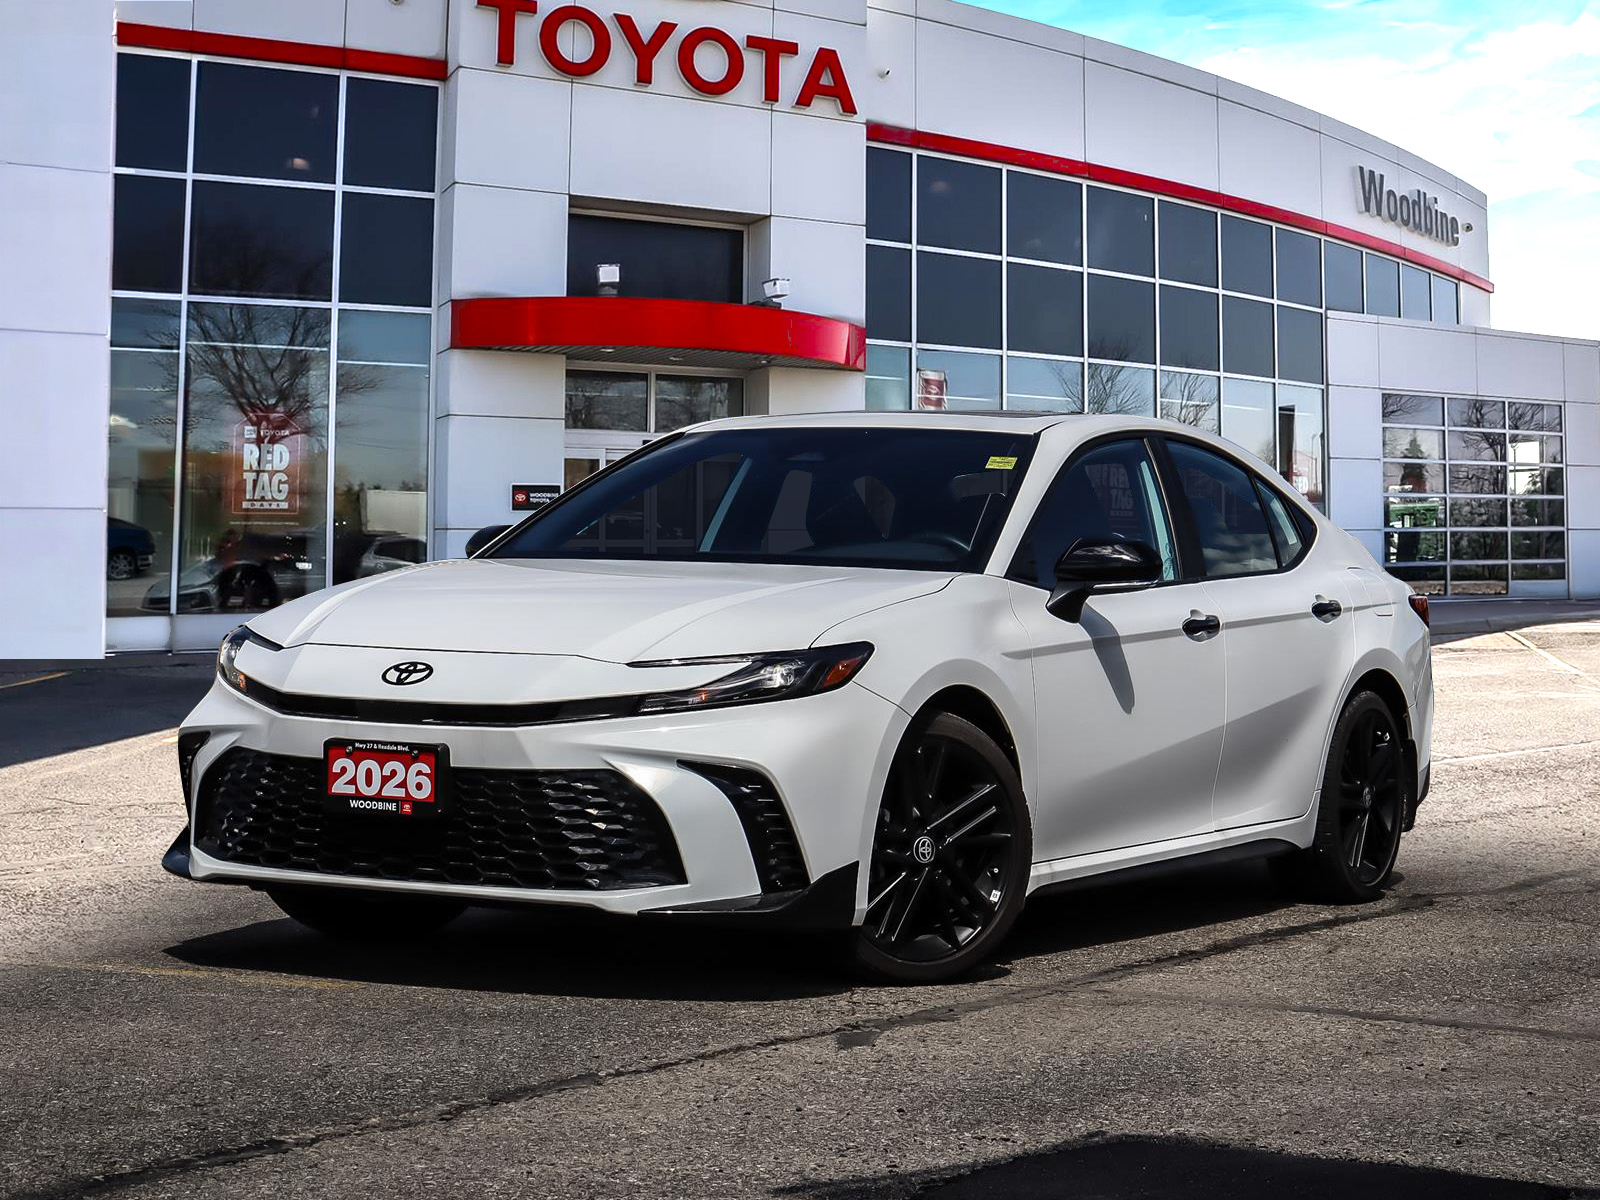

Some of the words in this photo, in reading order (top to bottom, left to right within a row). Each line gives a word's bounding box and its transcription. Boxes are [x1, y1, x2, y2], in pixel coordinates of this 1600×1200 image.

[476, 0, 858, 116] TOYOTA
[1357, 165, 1460, 246] Woodbine
[243, 443, 290, 471] RED
[243, 472, 289, 500] TAG
[332, 758, 431, 799] 2026
[349, 799, 397, 811] WOODBINE
